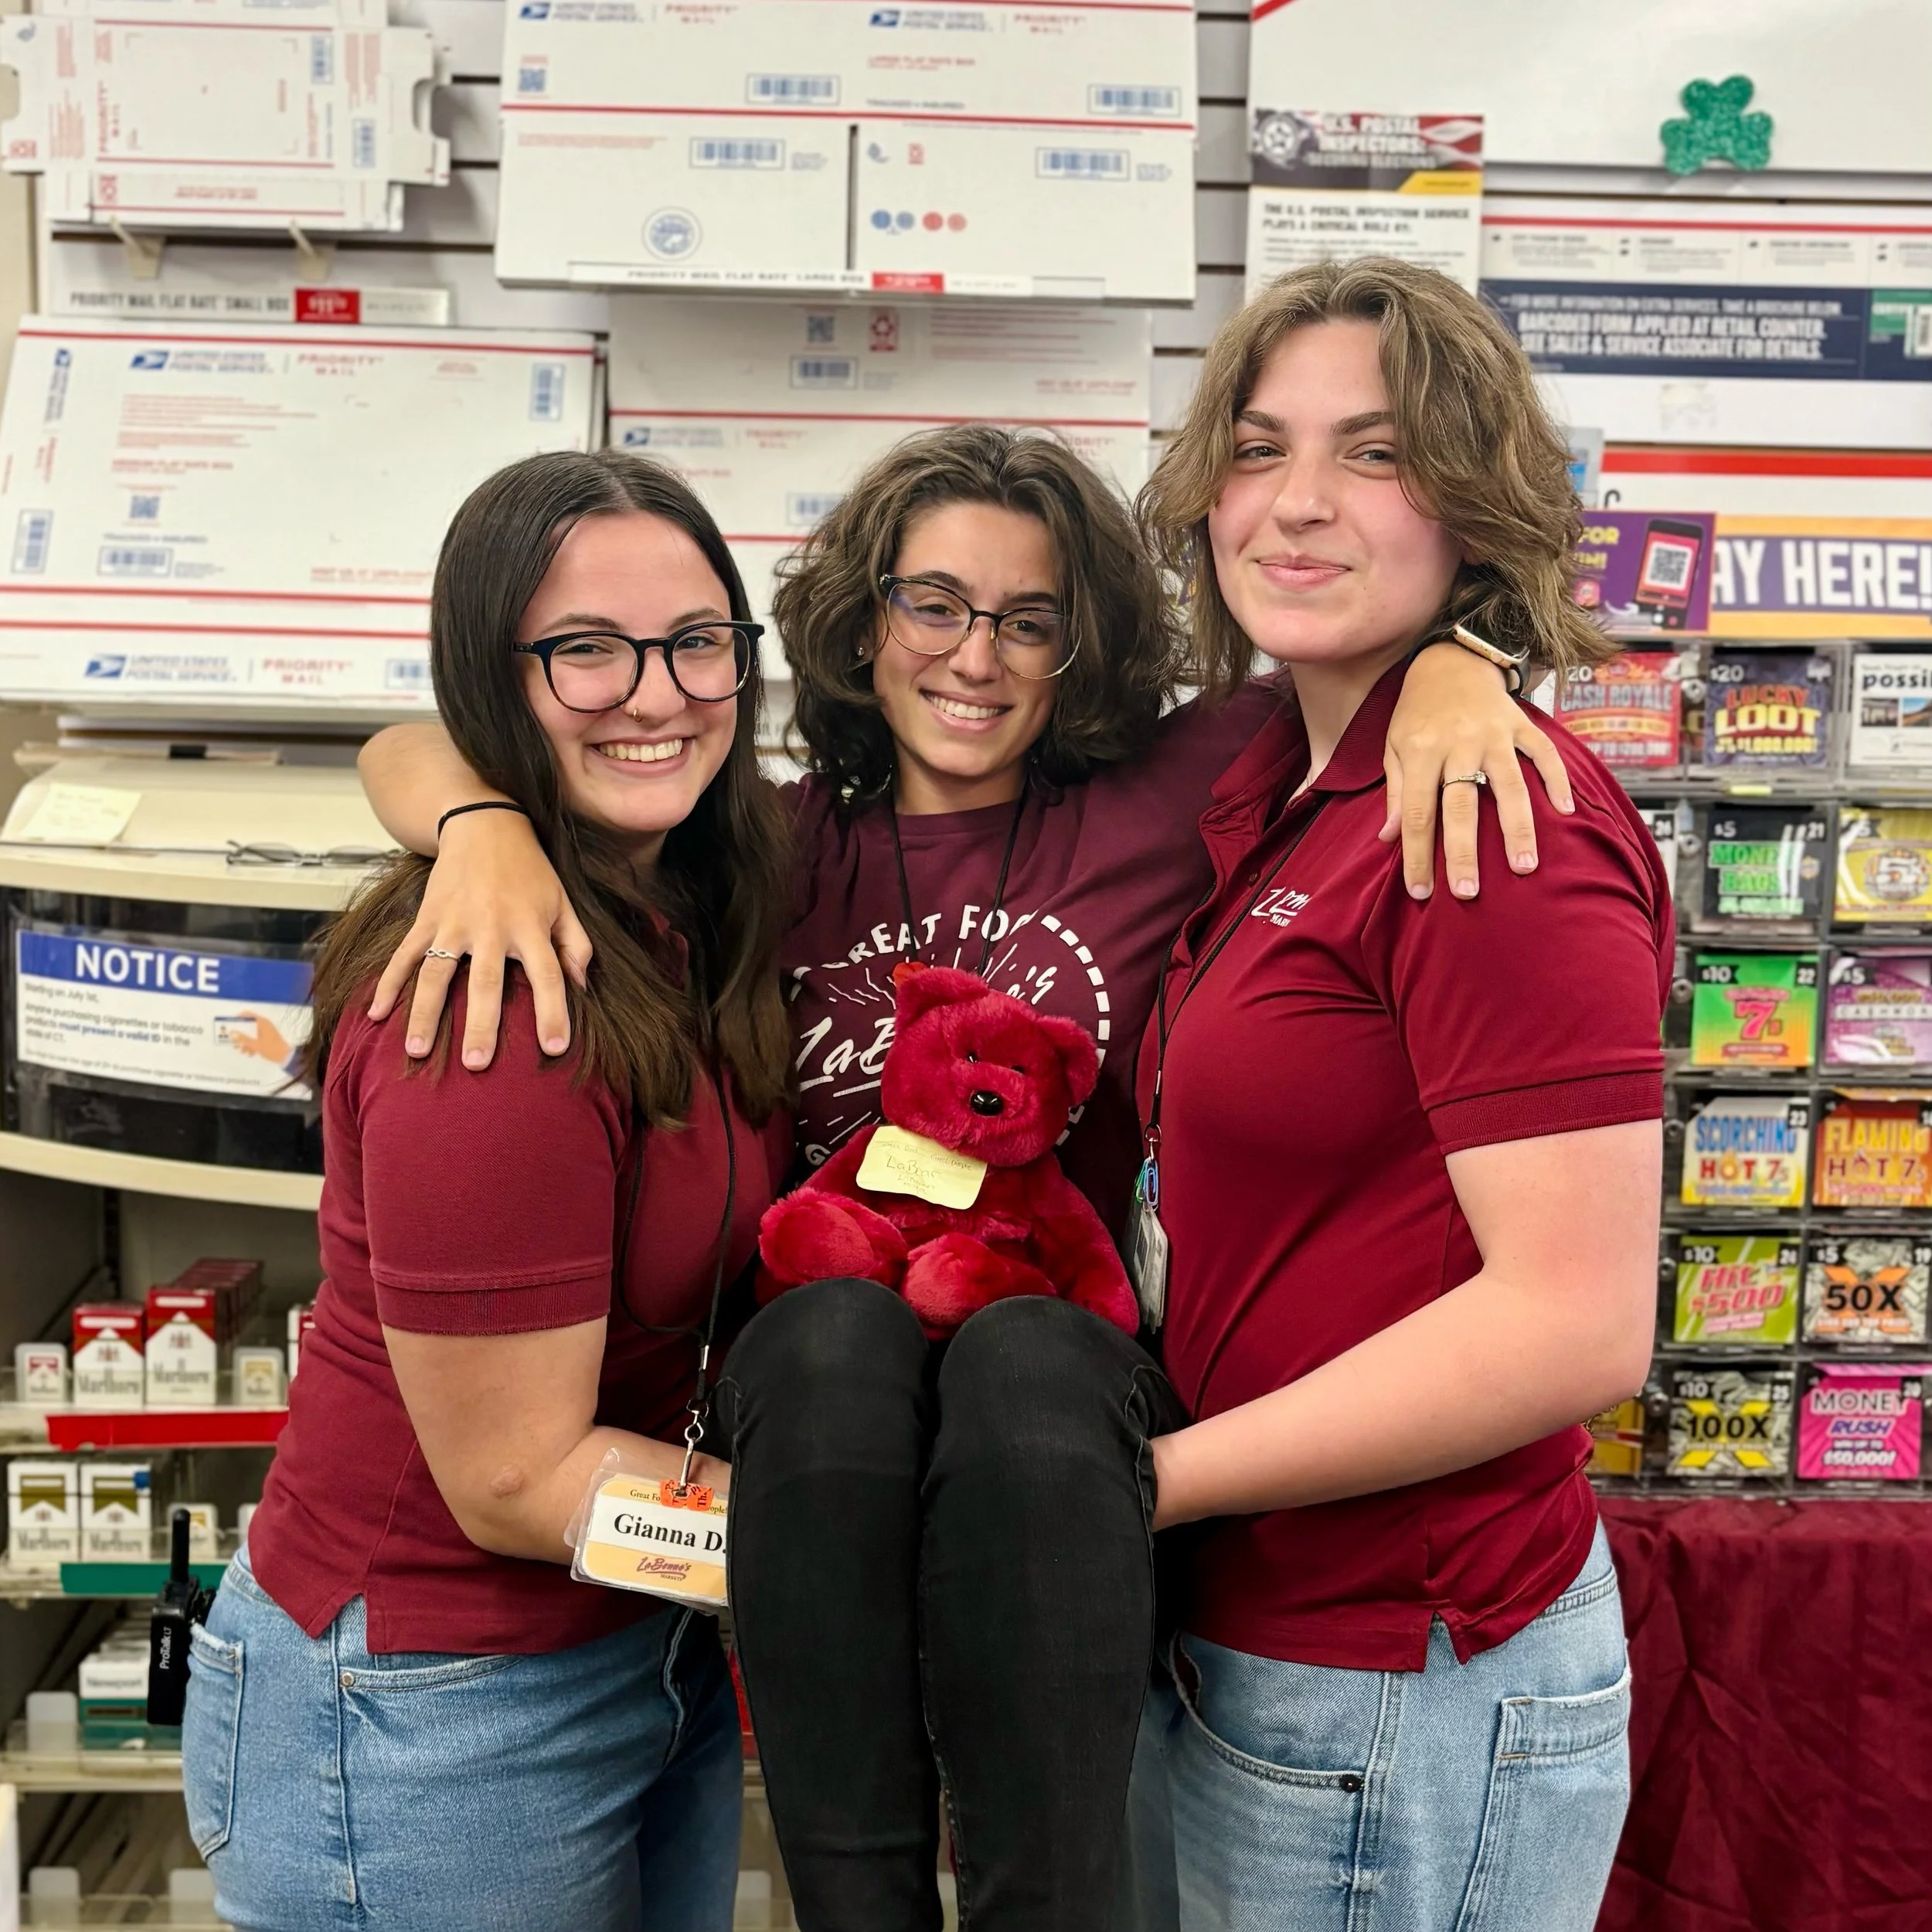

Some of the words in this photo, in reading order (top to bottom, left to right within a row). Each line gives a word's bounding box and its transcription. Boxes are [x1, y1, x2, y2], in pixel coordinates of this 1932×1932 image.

[1518, 311, 1591, 333] BARCODED
[1593, 313, 1634, 335] FORM
[1634, 314, 1692, 335] APPLIED
[1710, 316, 1757, 337] RETAIL
[1546, 333, 1590, 355] SALES
[1604, 335, 1662, 356] SERVICE
[1662, 335, 1736, 358] ASSOCIATE
[1713, 539, 1765, 604] AY
[1782, 540, 1932, 611] HERE!
[262, 658, 345, 672] PRIORITY
[281, 673, 325, 685] MAIL
[1862, 668, 1932, 692] possi
[1561, 683, 1606, 713] CASH
[1609, 684, 1672, 713] ROYALE
[1726, 684, 1810, 709] LUCKY
[1715, 703, 1822, 736] LOOT
[827, 913, 941, 967] REAT
[76, 944, 221, 993] NOTICE
[66, 988, 84, 1002] July
[53, 1007, 101, 1025] purchasing
[102, 1013, 148, 1029] cigarettes
[162, 1020, 204, 1036] tobacco
[59, 1021, 80, 1032] must
[82, 1023, 117, 1038] present
[126, 1029, 151, 1042] valid
[174, 1034, 190, 1046] the
[1696, 1116, 1797, 1153] SCORCHING
[1825, 1118, 1930, 1154] FLAMING
[1700, 1155, 1757, 1180] HOT
[1825, 1284, 1903, 1311] 50X
[1813, 1390, 1906, 1413] MONEY
[1688, 1415, 1769, 1439] 100X
[1829, 1420, 1891, 1435] RUSH
[630, 1489, 650, 1500] Great
[614, 1513, 696, 1548] Gianna
[703, 1530, 726, 1553] D.
[159, 1634, 172, 1669] ProTalk
